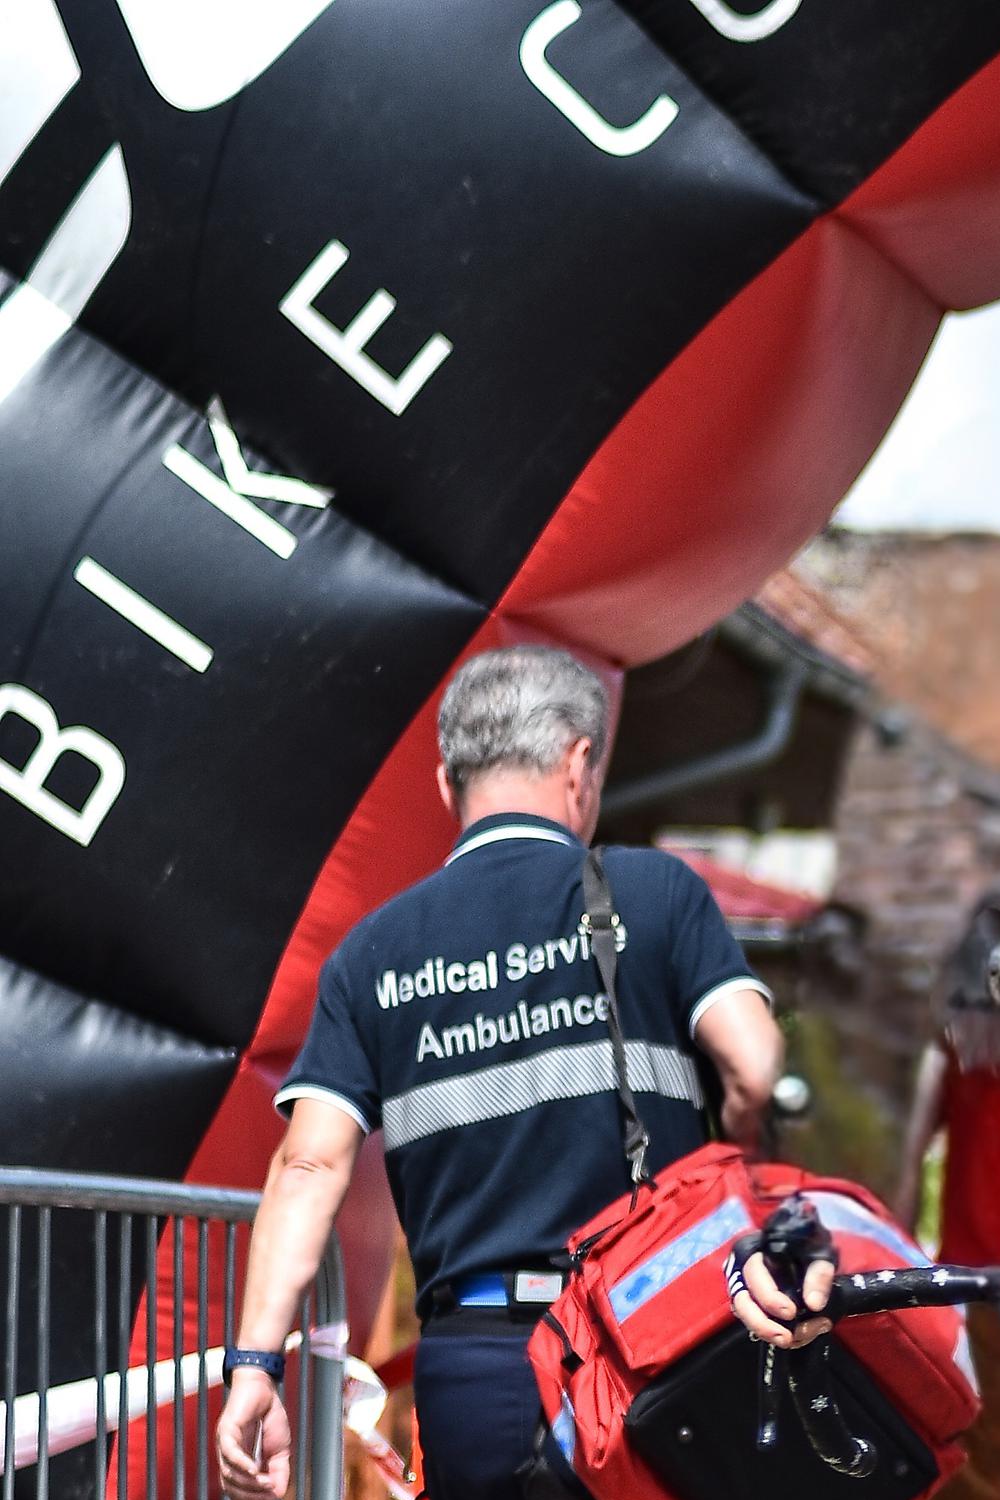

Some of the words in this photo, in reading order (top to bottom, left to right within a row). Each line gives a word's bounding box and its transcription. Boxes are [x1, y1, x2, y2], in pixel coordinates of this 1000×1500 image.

[0, 238, 453, 847] BIKE
[518, 0, 801, 157] C
[376, 950, 498, 1009] Medical
[505, 922, 628, 982] Servie
[416, 992, 610, 1063] Ambulance
